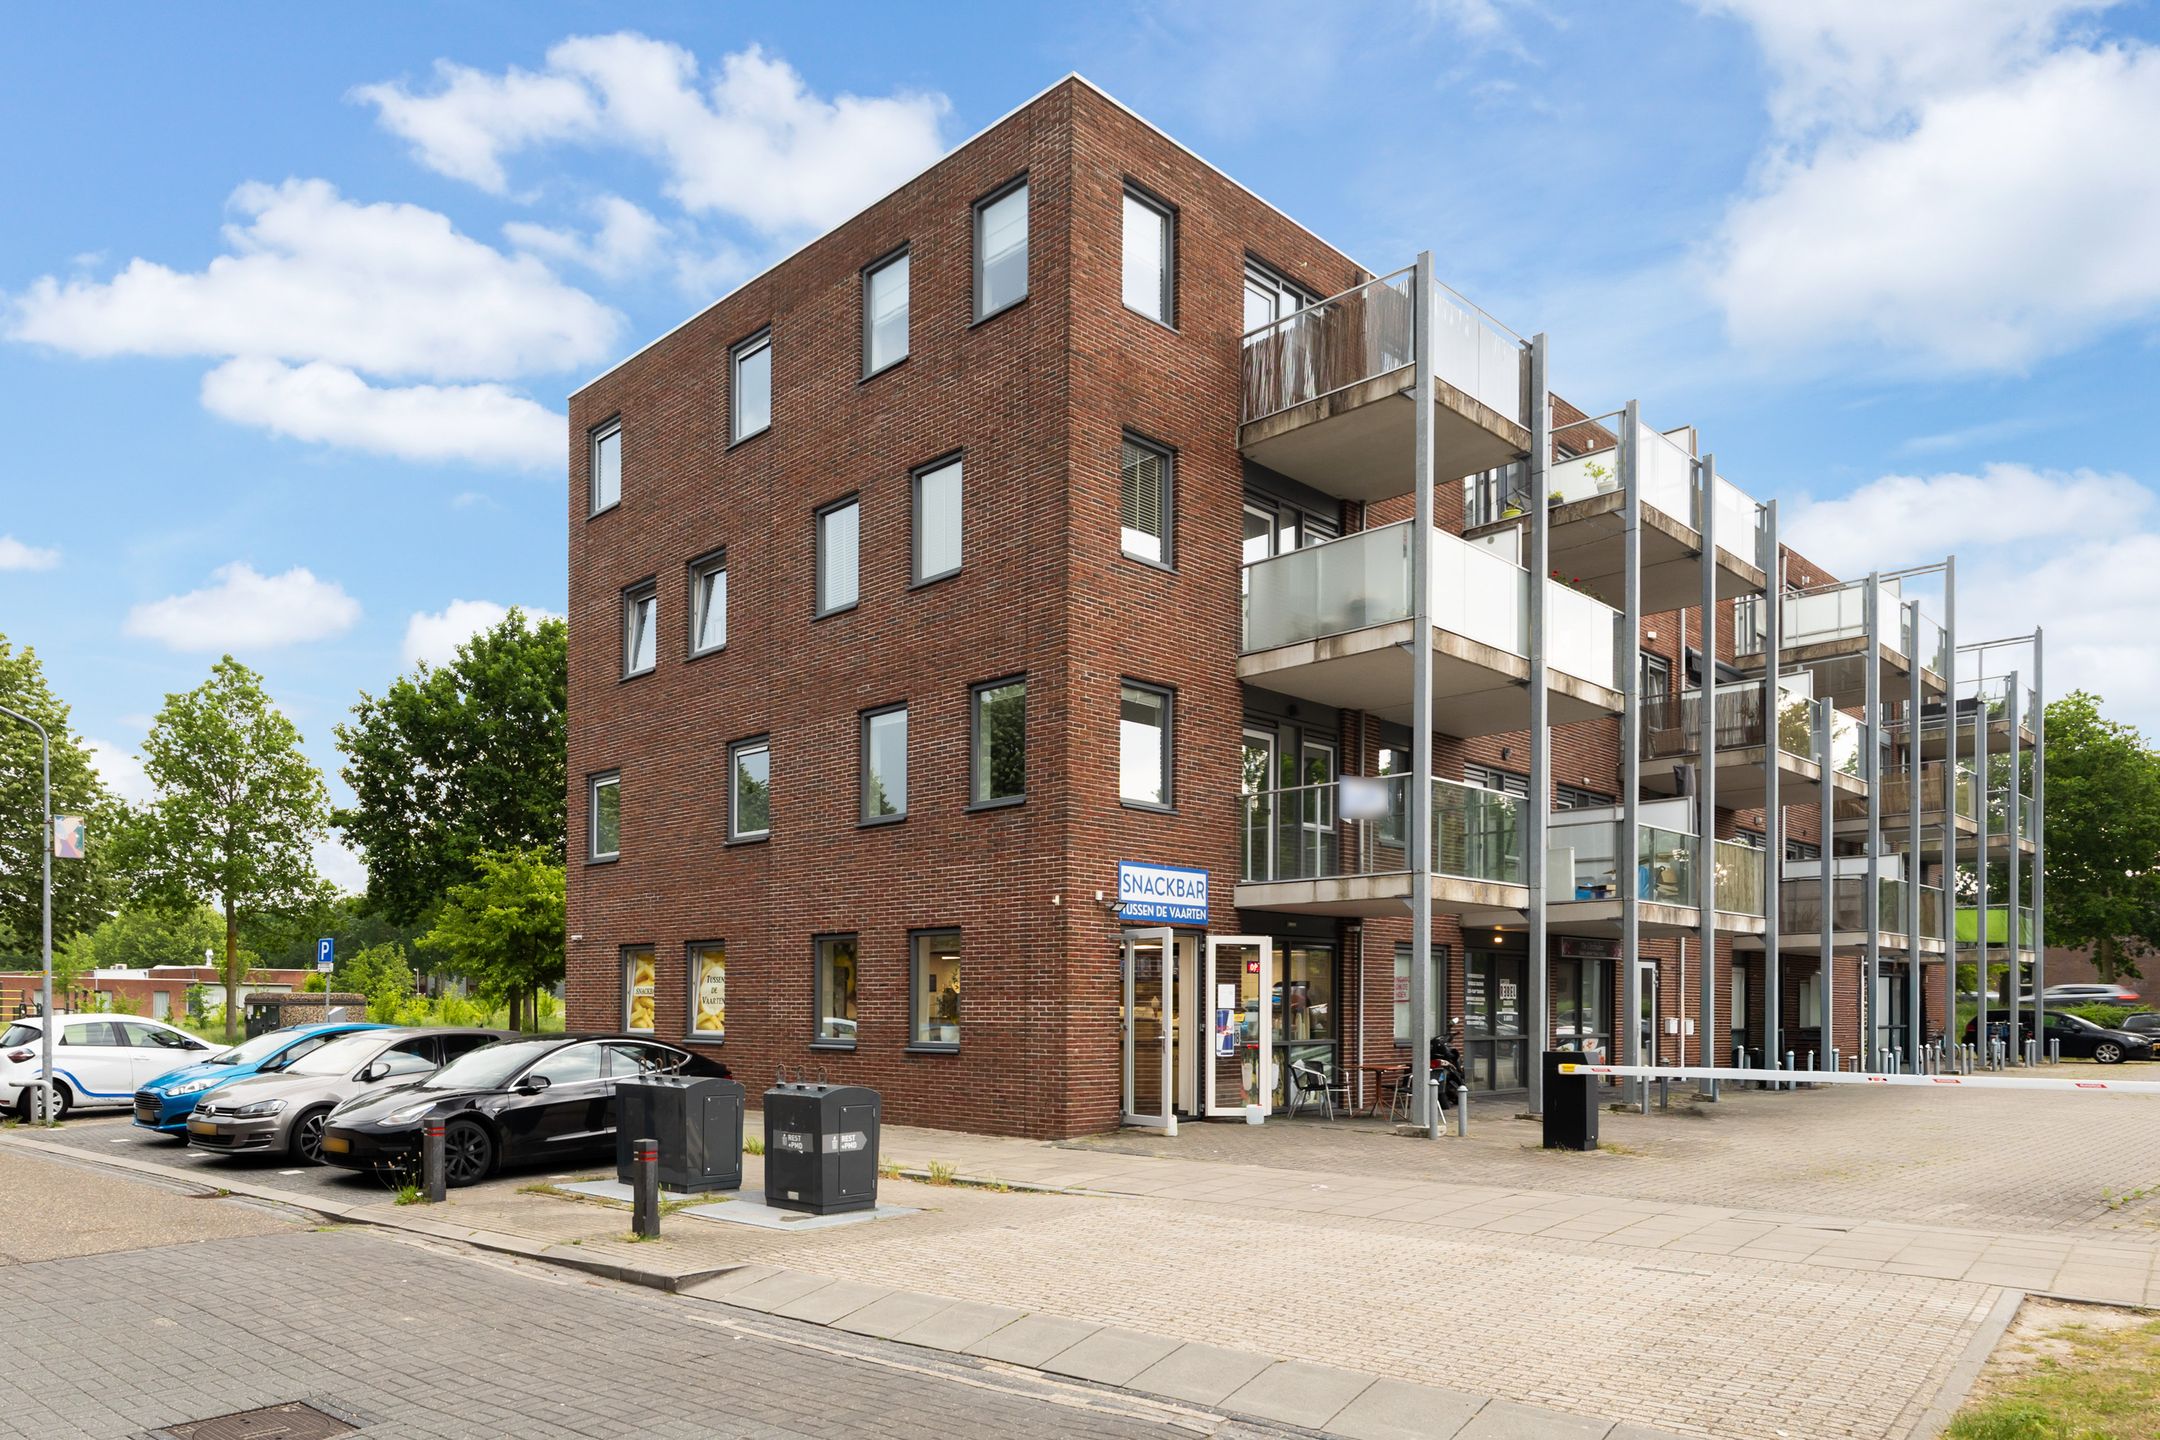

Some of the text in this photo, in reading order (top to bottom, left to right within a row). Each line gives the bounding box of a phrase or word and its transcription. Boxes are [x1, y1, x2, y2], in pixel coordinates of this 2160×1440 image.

[1123, 873, 1204, 899] SNACKBAR
[1156, 905, 1167, 917] DE
[1169, 906, 1206, 920] VAARTEN
[321, 941, 329, 960] P
[787, 1134, 801, 1142] REST
[841, 1134, 856, 1142] REST
